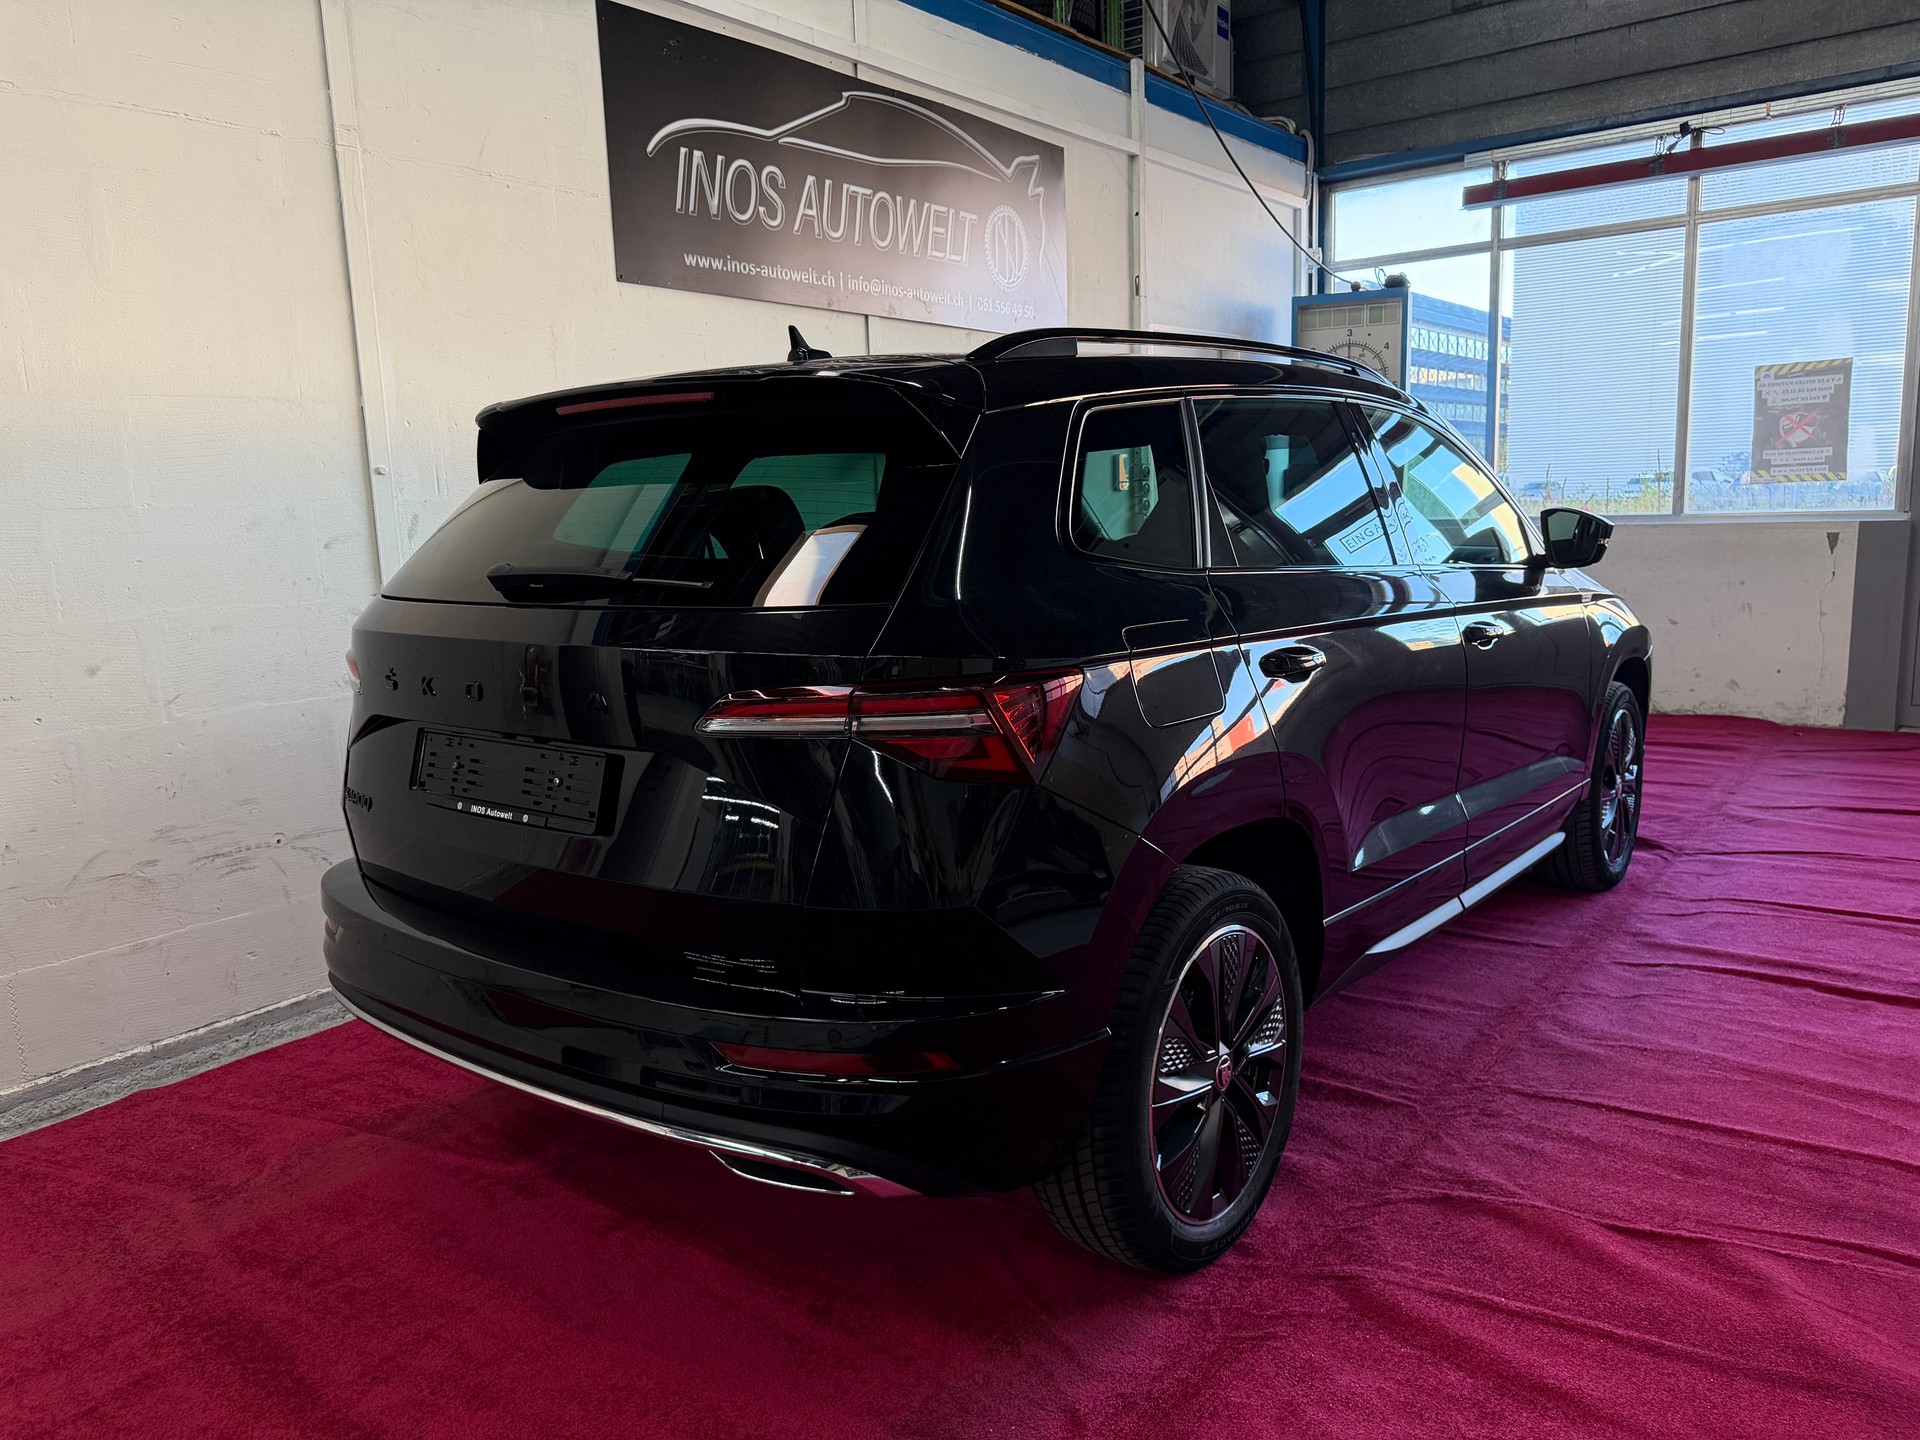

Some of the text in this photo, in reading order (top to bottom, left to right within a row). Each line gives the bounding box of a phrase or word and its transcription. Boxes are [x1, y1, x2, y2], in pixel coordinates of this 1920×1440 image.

[675, 146, 978, 267] INOS AUTOWELT
[683, 252, 835, 288] www.inos-autowelt.ch
[848, 274, 964, 308] info@inos-autowelt.ch
[995, 300, 1011, 315] 556
[1012, 303, 1023, 317] 49
[1024, 305, 1035, 319] 50
[1346, 328, 1353, 338] 3
[1383, 341, 1390, 350] 4
[470, 804, 513, 820] INOS Autowelt
